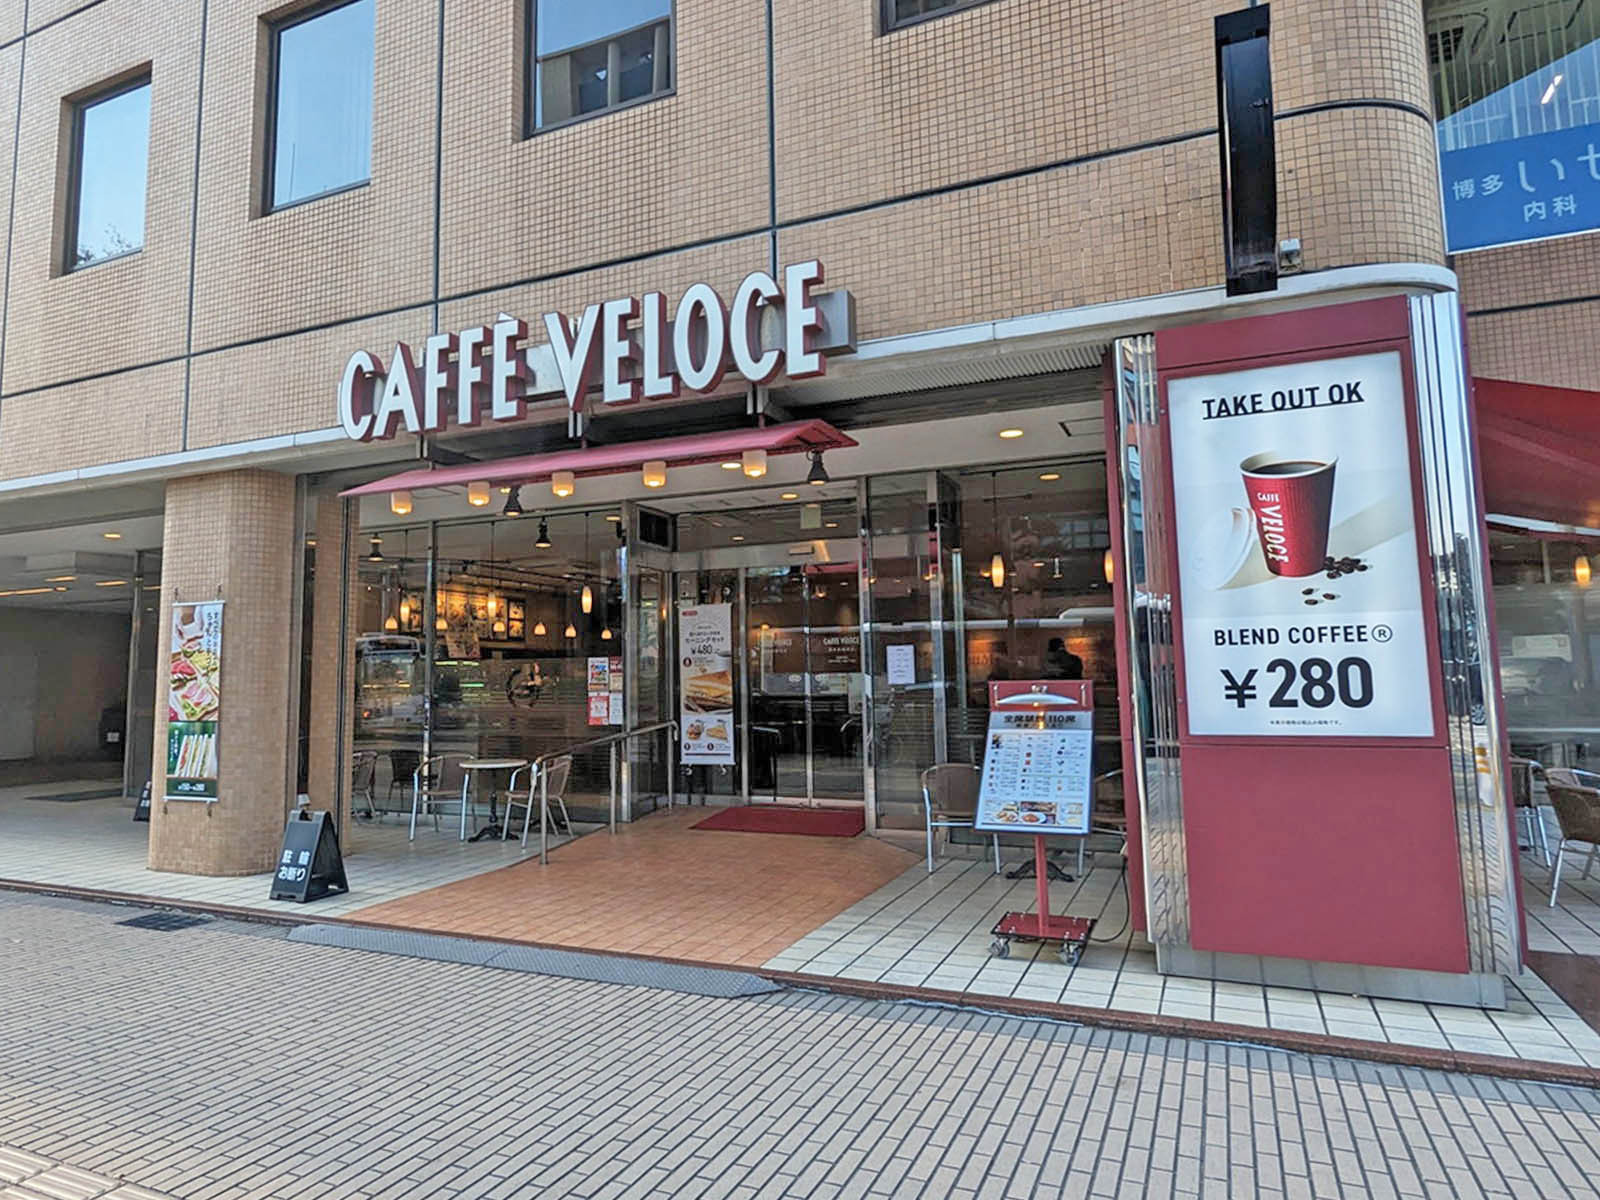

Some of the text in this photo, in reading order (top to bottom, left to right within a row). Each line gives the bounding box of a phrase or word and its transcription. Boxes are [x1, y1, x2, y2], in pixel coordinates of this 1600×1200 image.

[1452, 174, 1503, 201] 博多
[1523, 194, 1577, 223] 内科
[543, 259, 824, 412] VELOCE
[1202, 381, 1364, 420] TAKE OUT OK
[1260, 504, 1289, 563] VELOCE
[1214, 627, 1280, 646] BLEND
[1219, 656, 1374, 709] ¥280
